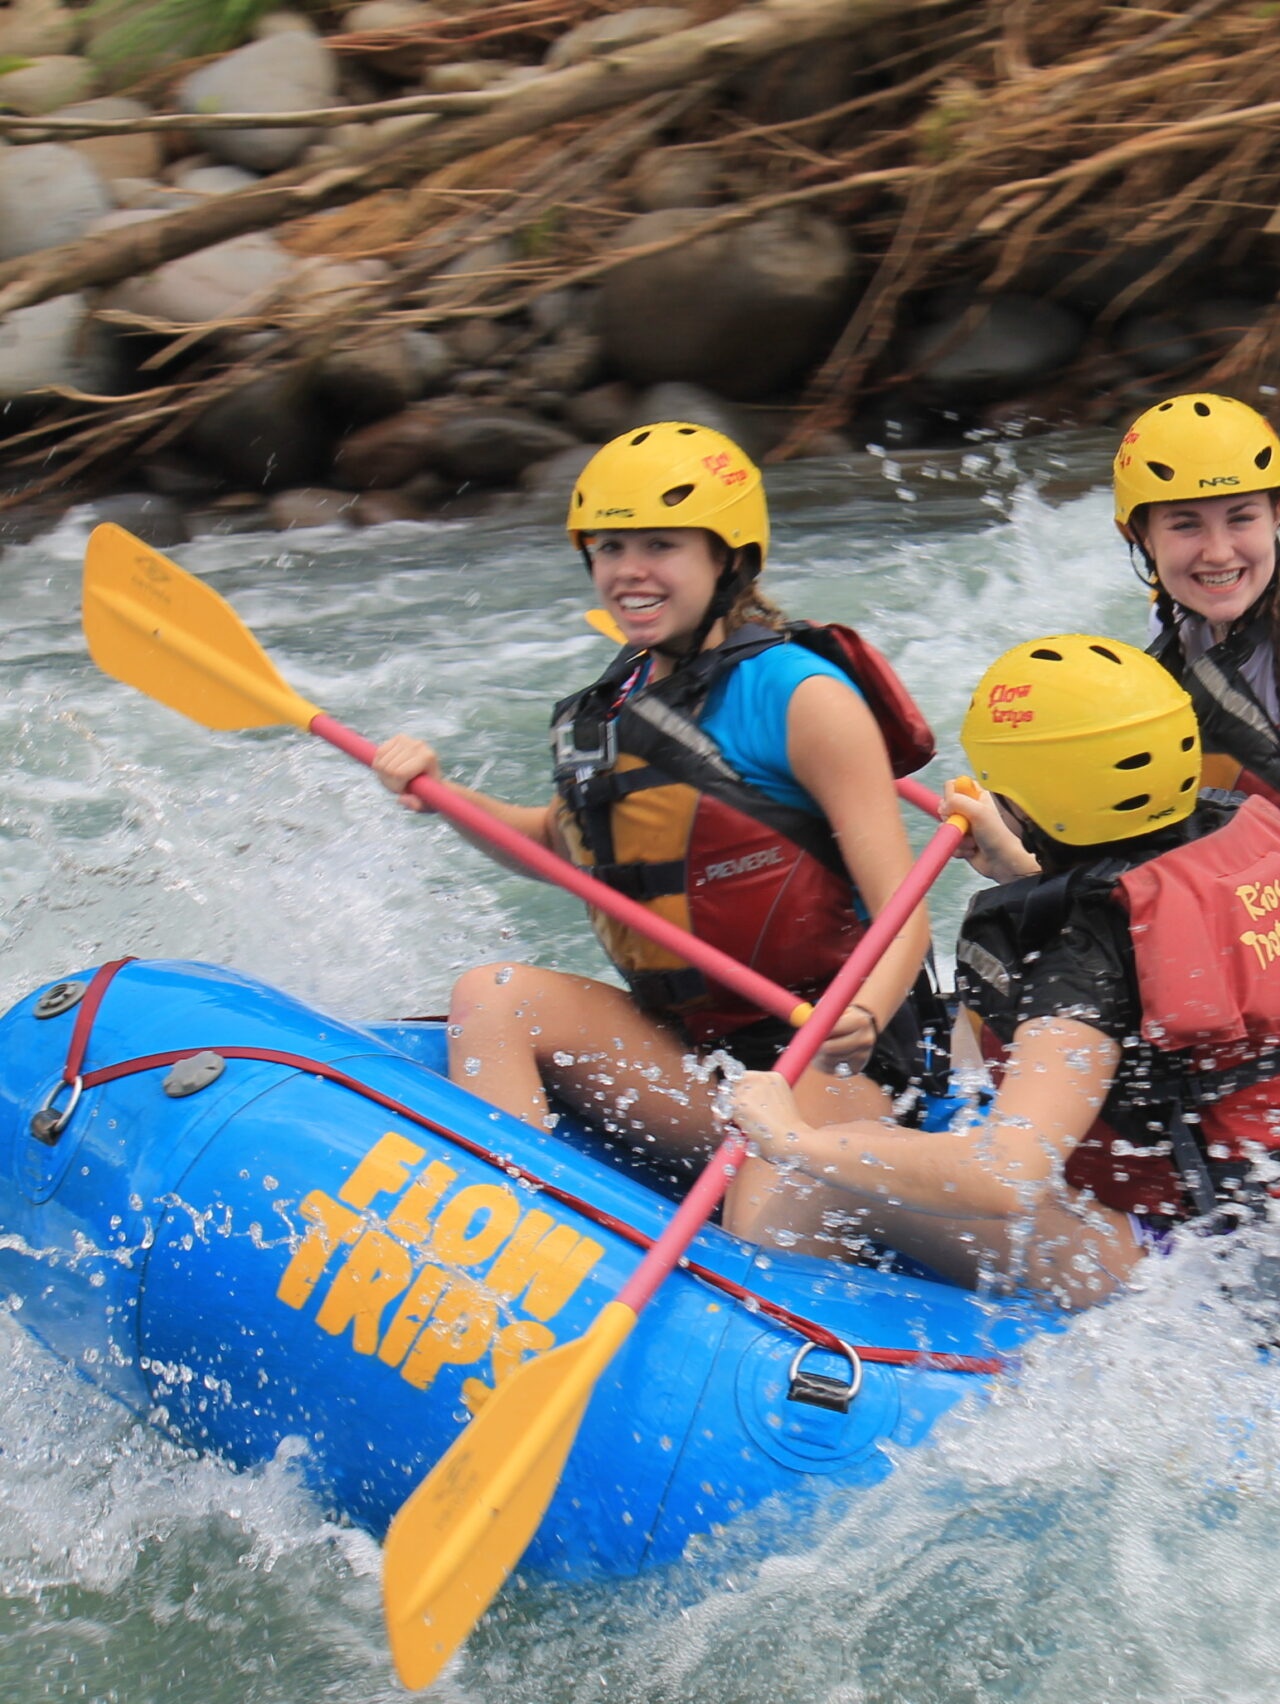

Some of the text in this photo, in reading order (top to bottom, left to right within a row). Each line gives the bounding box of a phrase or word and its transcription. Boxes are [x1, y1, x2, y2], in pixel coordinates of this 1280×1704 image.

[1199, 476, 1240, 488] NRS
[991, 707, 1034, 729] trips
[703, 846, 785, 882] REVERE
[338, 1131, 606, 1322] FLOW
